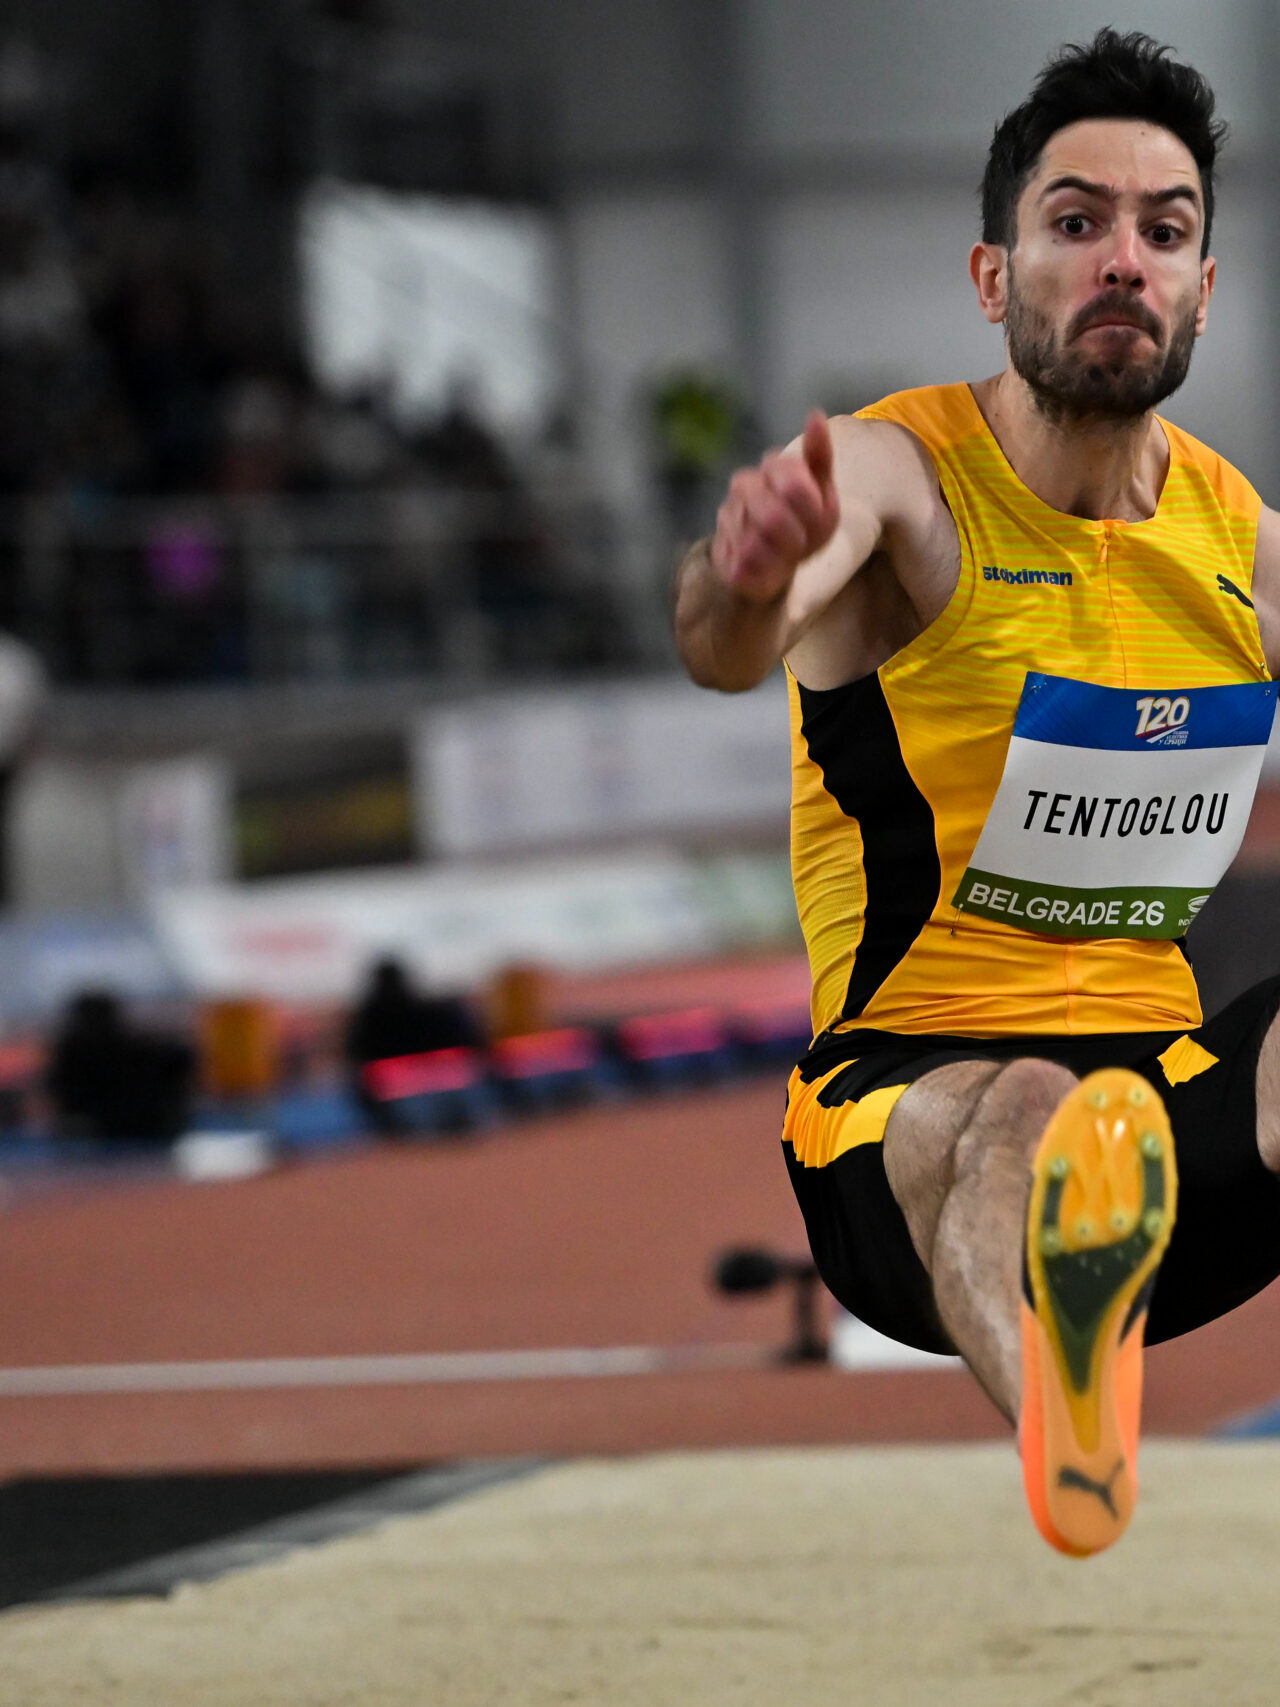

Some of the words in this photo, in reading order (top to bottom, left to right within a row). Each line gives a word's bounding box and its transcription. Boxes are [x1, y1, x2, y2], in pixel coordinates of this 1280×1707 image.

[1135, 696, 1190, 736] 120
[1023, 789, 1229, 838] TENTOGLOU
[967, 882, 1123, 926] BELGRADE
[1127, 900, 1166, 926] 26
